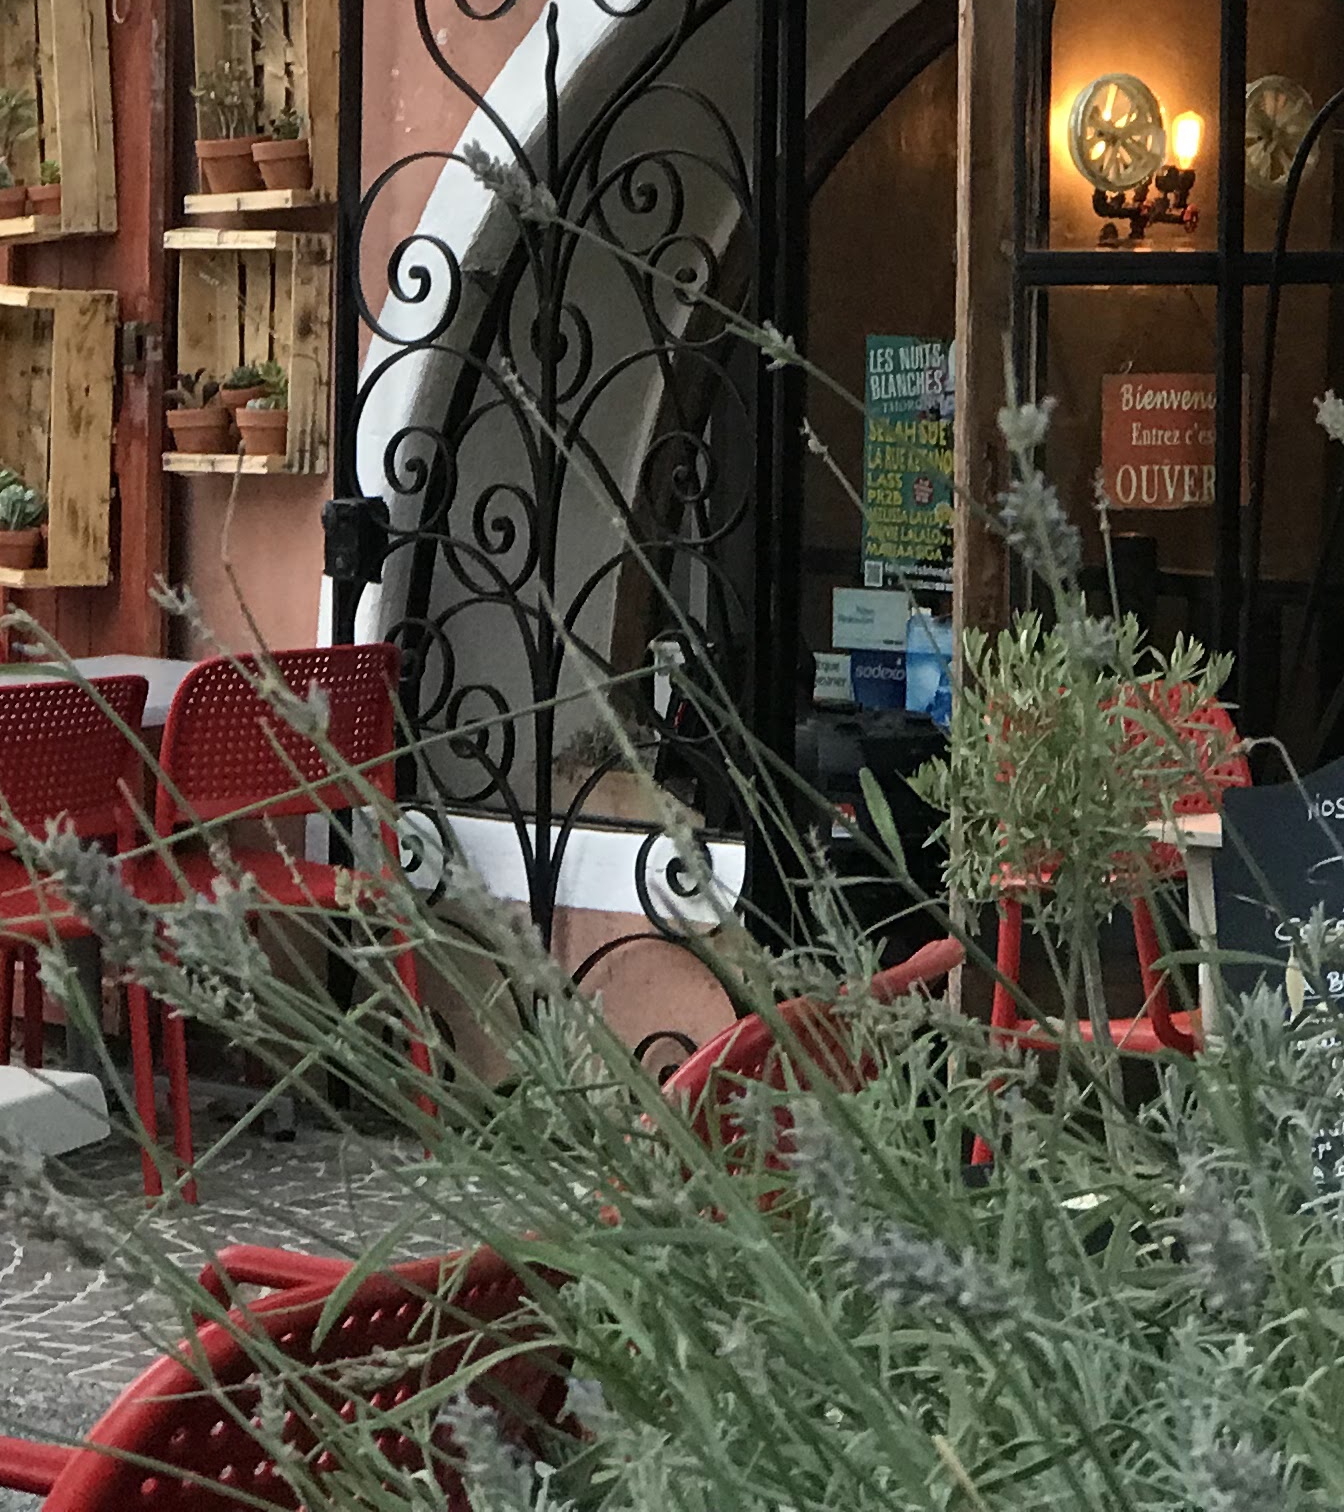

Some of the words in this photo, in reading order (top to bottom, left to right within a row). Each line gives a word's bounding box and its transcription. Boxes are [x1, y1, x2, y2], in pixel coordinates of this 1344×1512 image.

[869, 347, 894, 374] LES
[898, 343, 942, 371] NUITS
[869, 368, 944, 402] BLANCHES
[1121, 383, 1216, 411] Bienvenu
[1131, 422, 1181, 446] Entrez
[1184, 423, 1216, 445] c'es
[1116, 464, 1216, 504] OUVER
[856, 660, 906, 681] sodexo
